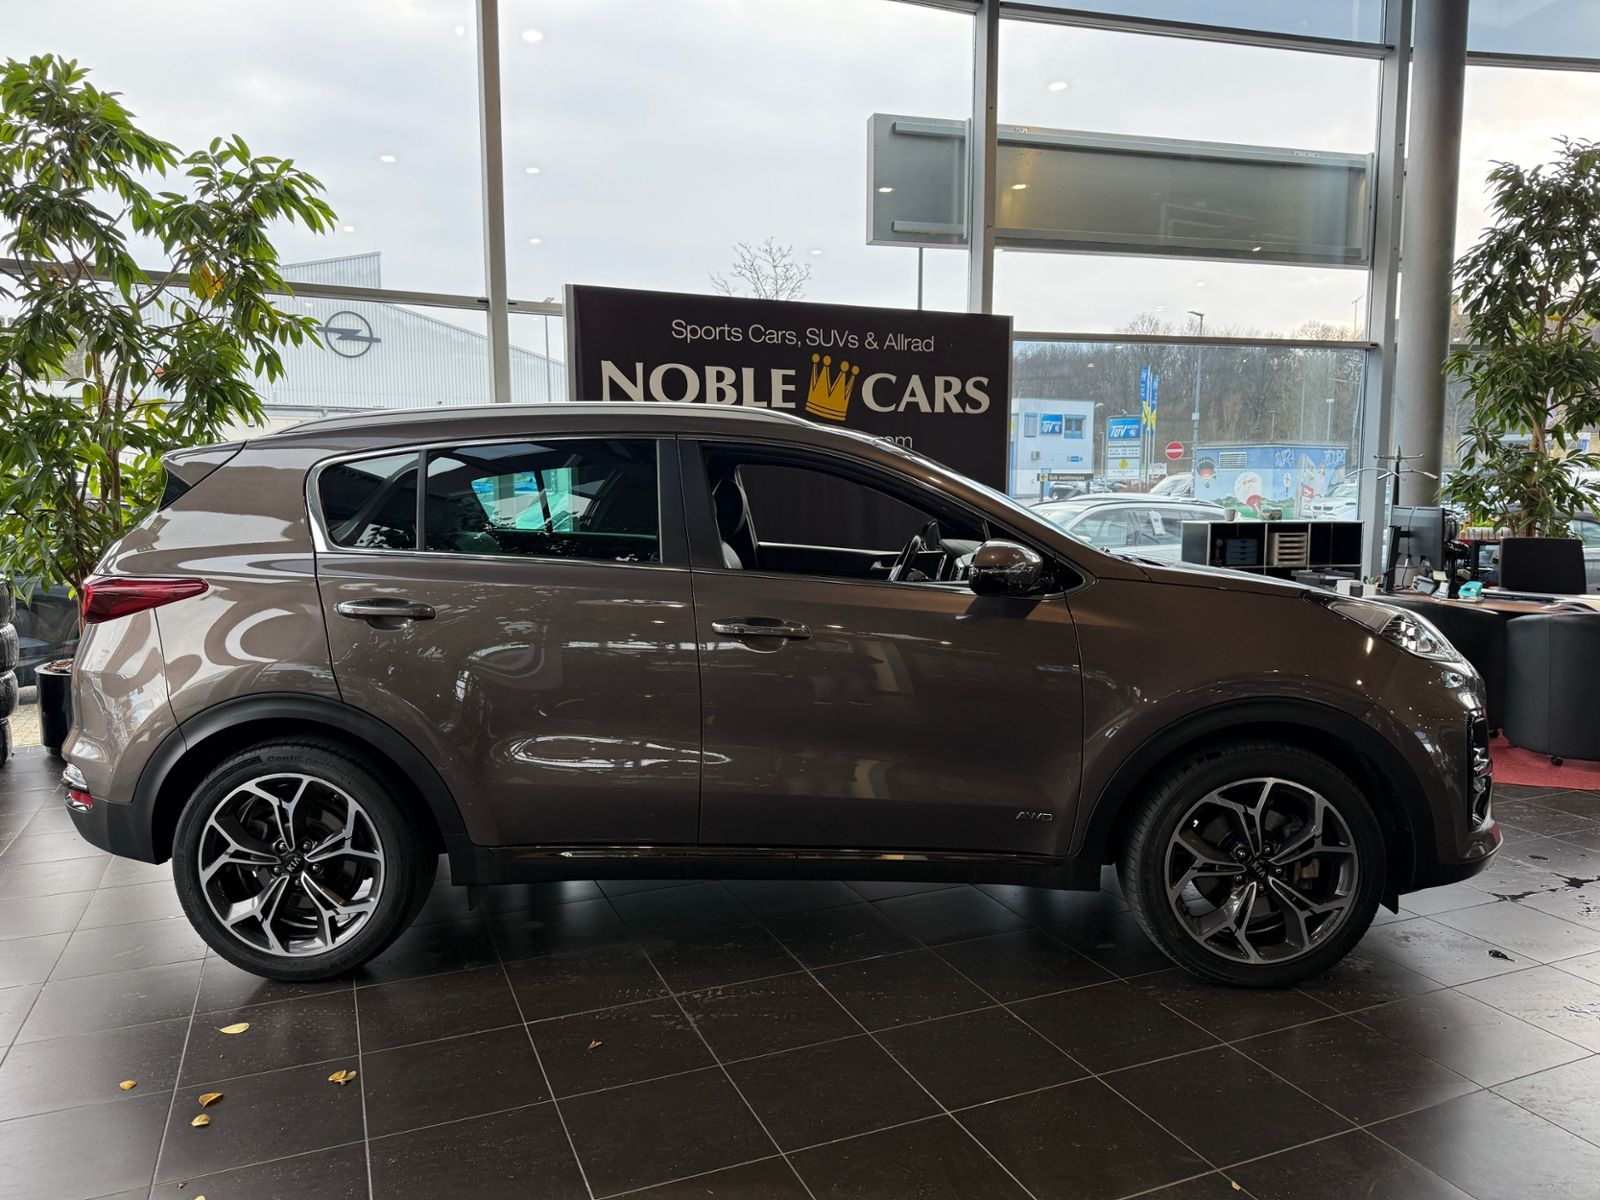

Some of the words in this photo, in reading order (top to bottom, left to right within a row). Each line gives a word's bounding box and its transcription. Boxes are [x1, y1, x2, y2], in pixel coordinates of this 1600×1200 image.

[671, 319, 743, 344] Sports
[748, 324, 802, 348] Cars,
[805, 327, 859, 349] SUVs
[864, 331, 879, 350] &
[883, 333, 935, 352] Allrad
[601, 360, 796, 409] NOBLE
[861, 372, 991, 415] CARS
[1016, 811, 1053, 821] AWD
[286, 856, 301, 872] KIA
[1252, 861, 1266, 878] KIA
